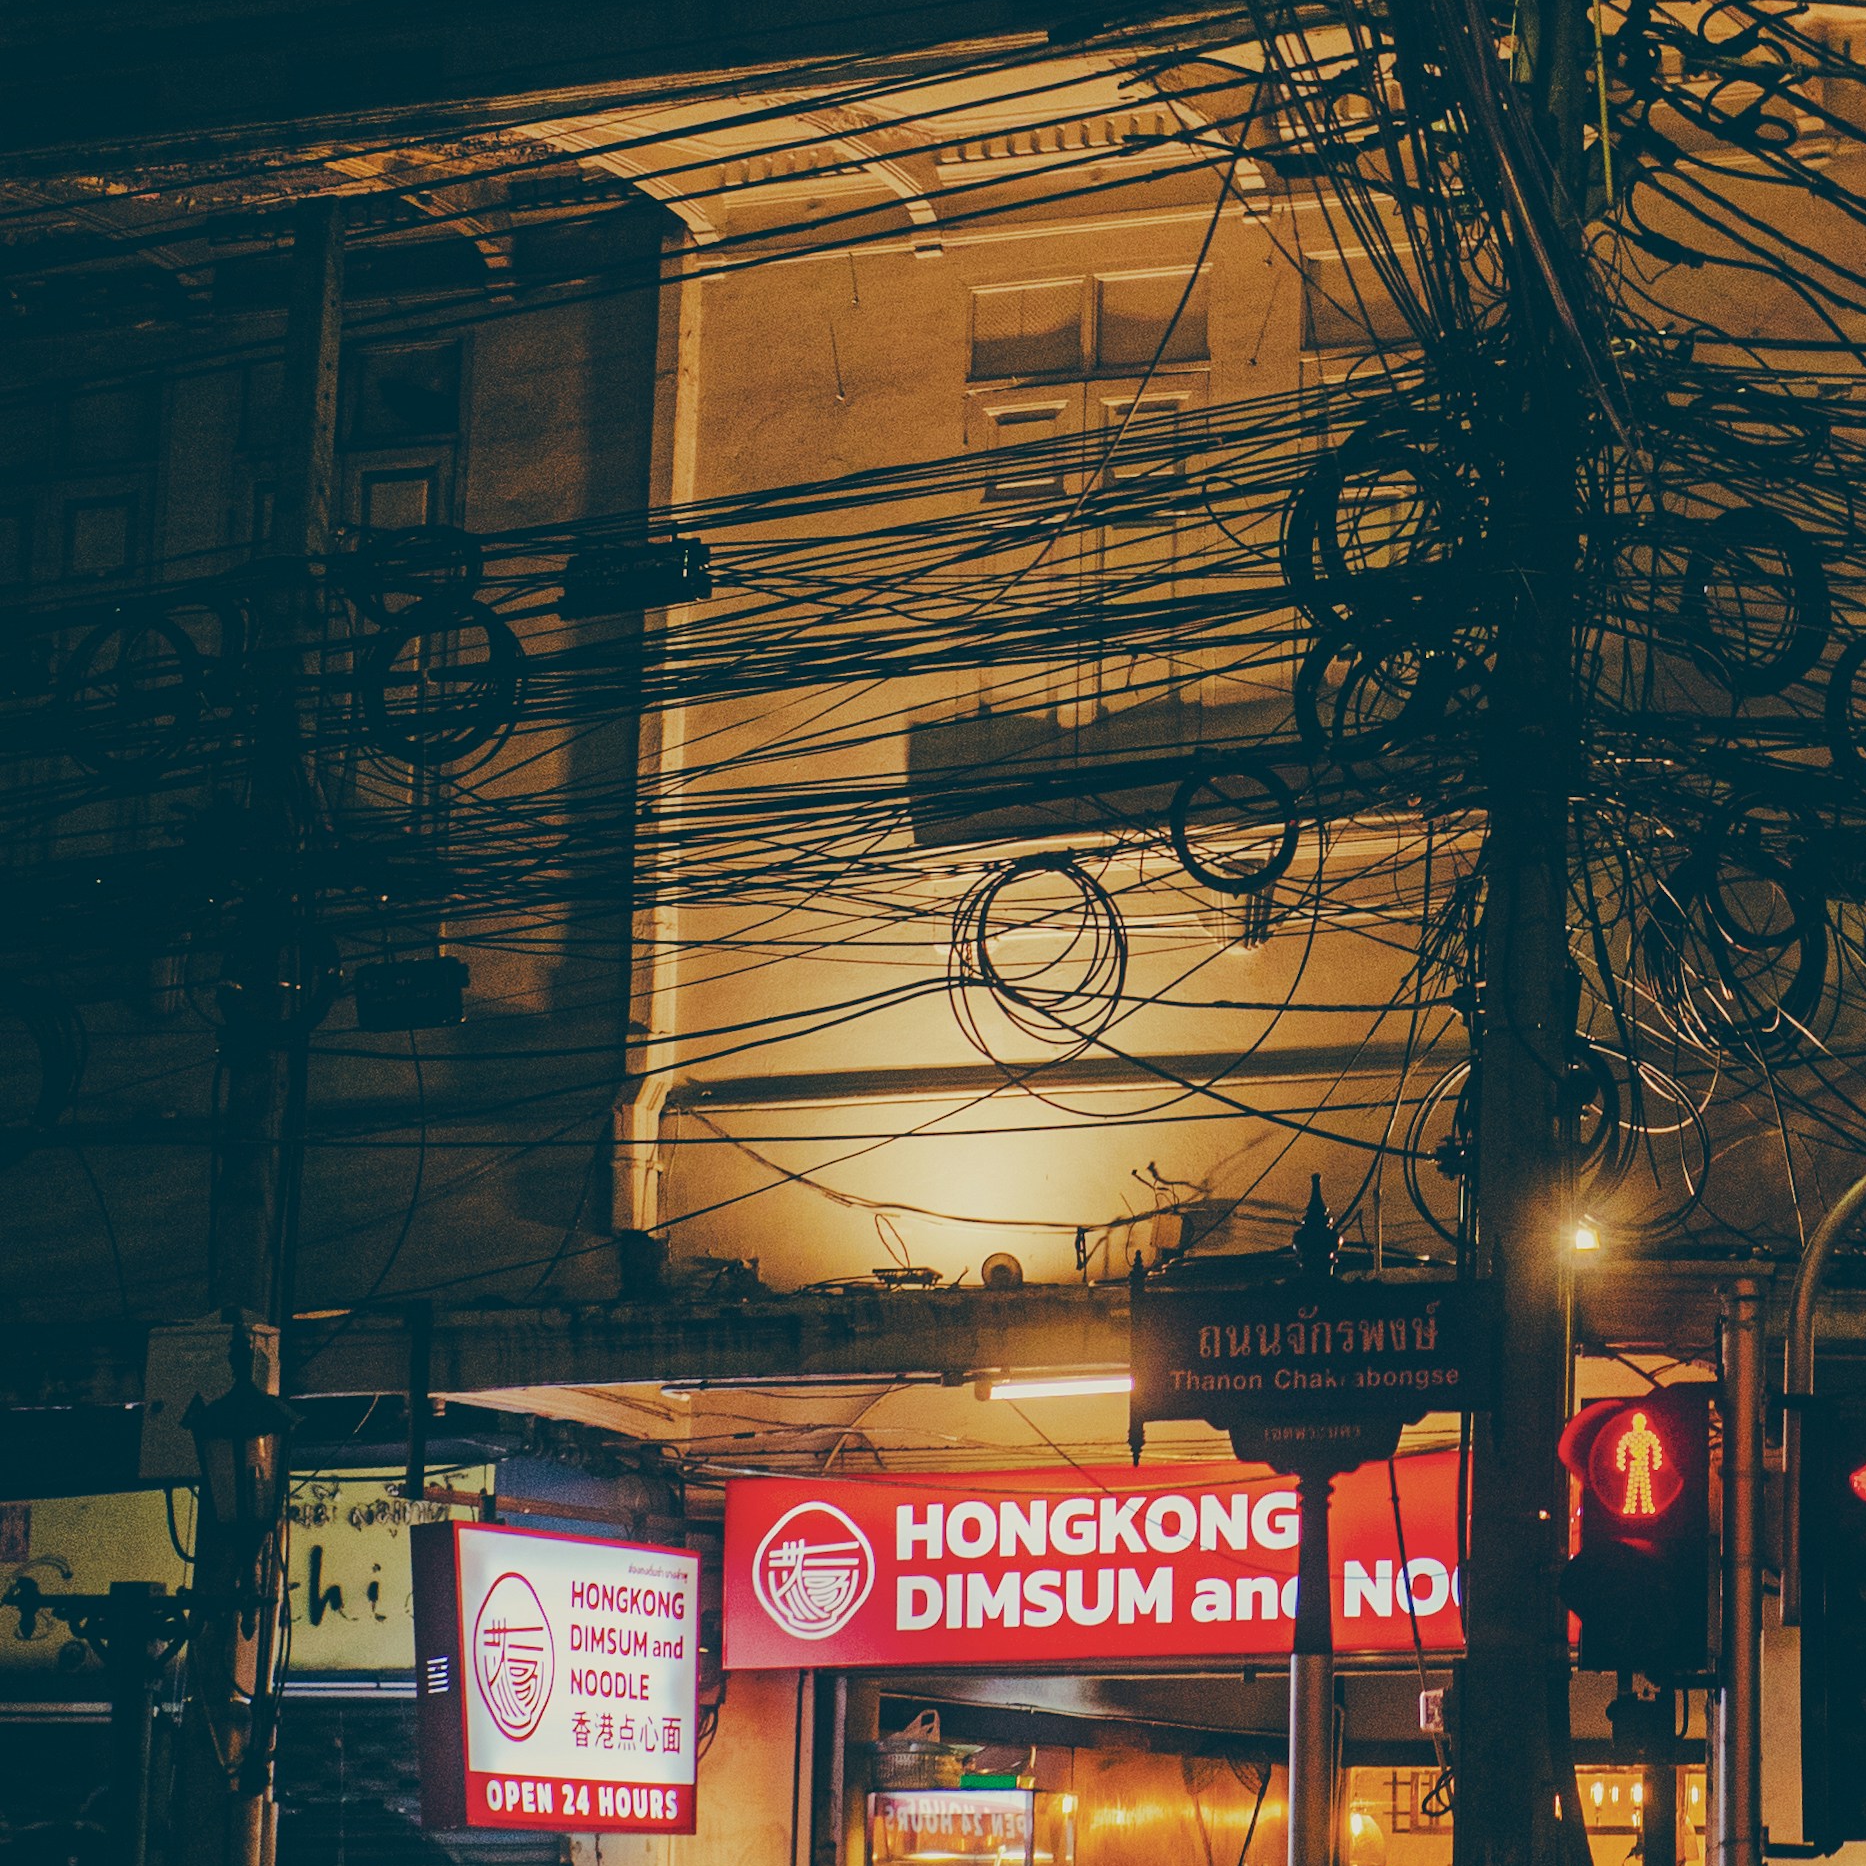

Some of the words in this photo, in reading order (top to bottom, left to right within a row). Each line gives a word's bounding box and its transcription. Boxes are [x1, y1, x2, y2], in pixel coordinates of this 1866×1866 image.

[1199, 1300, 1441, 1359] ถนนจักรพงษ์
[1169, 1369, 1263, 1391] Thanon
[896, 1491, 1299, 1561] HONGKONG
[572, 1580, 685, 1620] HONGKONG
[896, 1567, 1174, 1631] DIMSUM
[570, 1624, 648, 1658] DIMSUM
[652, 1635, 684, 1659] and
[570, 1668, 649, 1700] NOODLE
[571, 1711, 682, 1754] 香港点心面
[486, 1779, 553, 1814] OPEN
[561, 1783, 591, 1816] 24
[598, 1786, 678, 1821] HOURS
